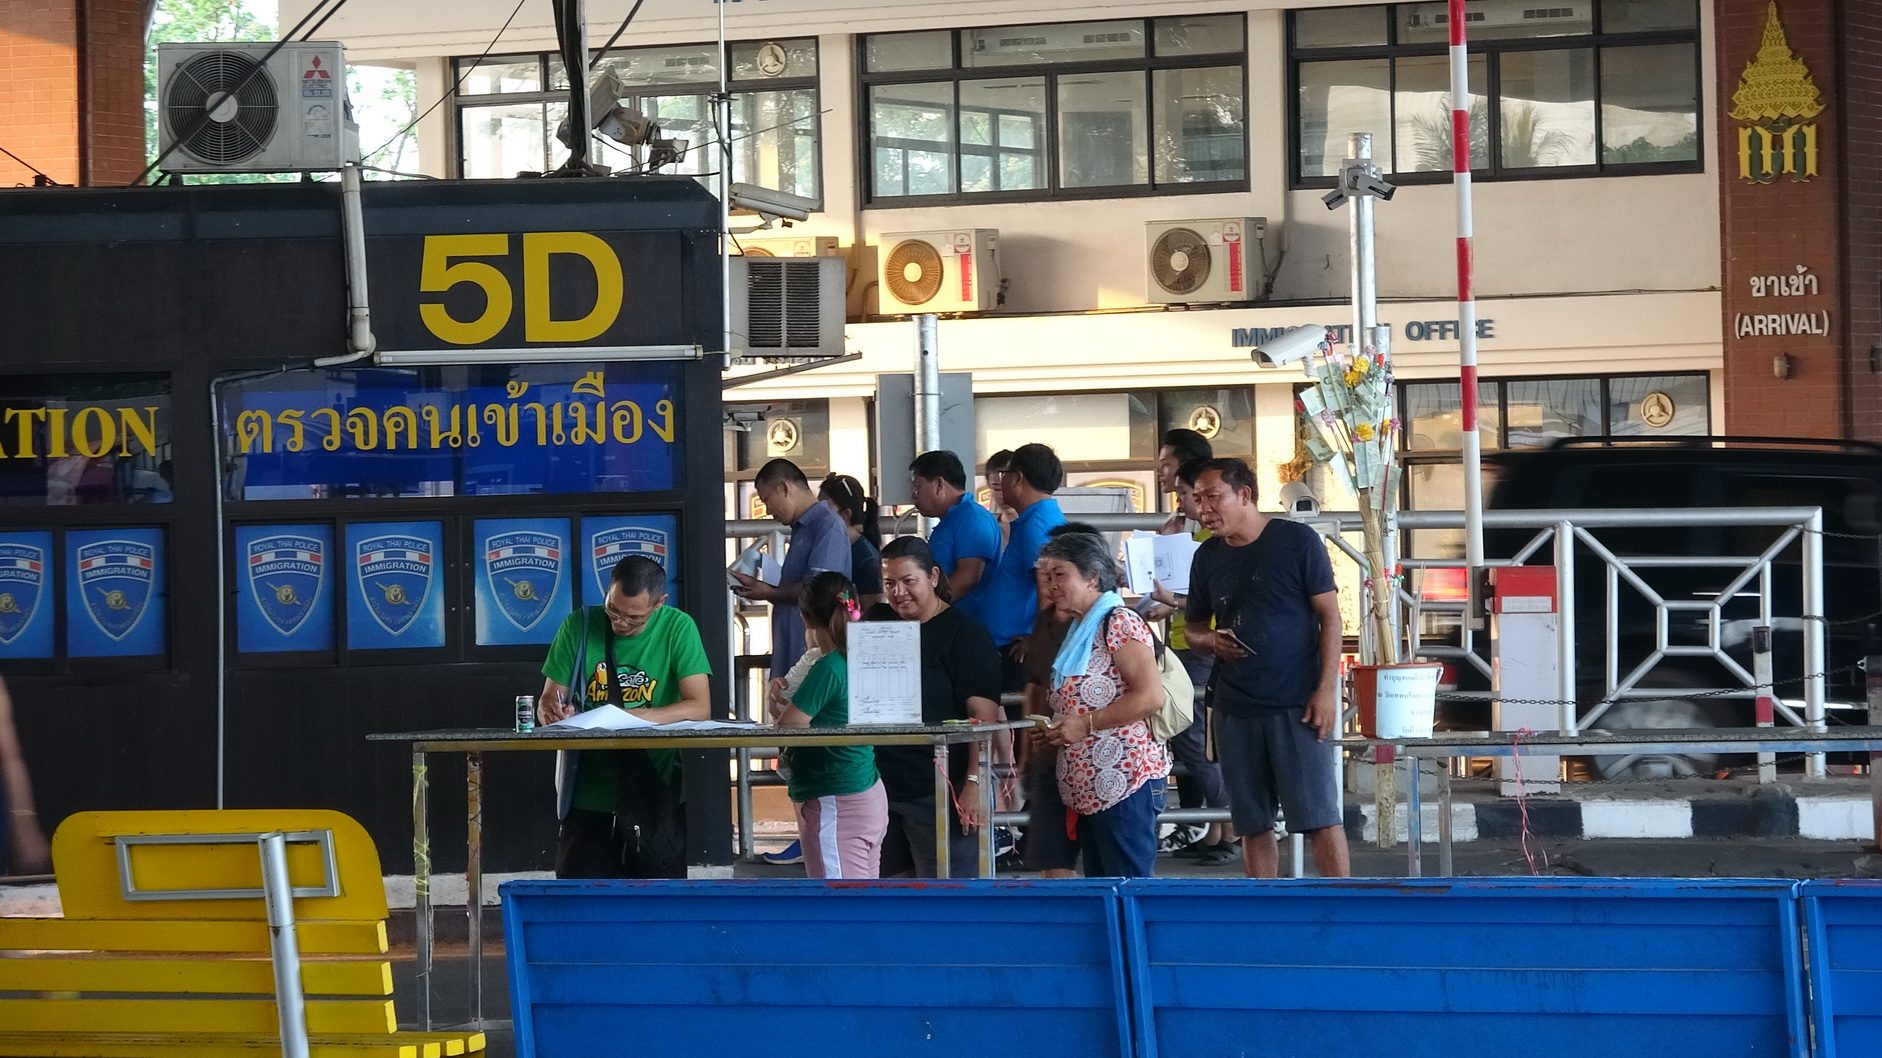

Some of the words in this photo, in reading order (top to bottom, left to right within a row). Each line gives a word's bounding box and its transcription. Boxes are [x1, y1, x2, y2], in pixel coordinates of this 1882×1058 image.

[1750, 264, 1819, 298] ขาเข้า
[418, 231, 624, 345] 5D
[1405, 318, 1495, 342] OFFIE
[1734, 309, 1830, 340] (ARRIVAL)
[235, 371, 676, 454] ตรวจคนเข้าเมือง
[0, 405, 160, 459] TION
[491, 538, 514, 548] ROYAL
[515, 536, 531, 544] THAI
[532, 536, 557, 547] POLICE
[597, 533, 620, 545] ROYAL
[621, 531, 637, 540] THAI
[638, 532, 663, 543] POLICE
[277, 540, 293, 548] THAI
[295, 541, 319, 551] POLICE
[386, 540, 401, 548] THAI
[403, 541, 428, 551] POLICE
[255, 562, 319, 574] IMMIGRATION
[364, 562, 427, 574] IMMIGRATION
[493, 557, 556, 569] IMMIGRATION
[85, 567, 149, 579] IMMIGRATION
